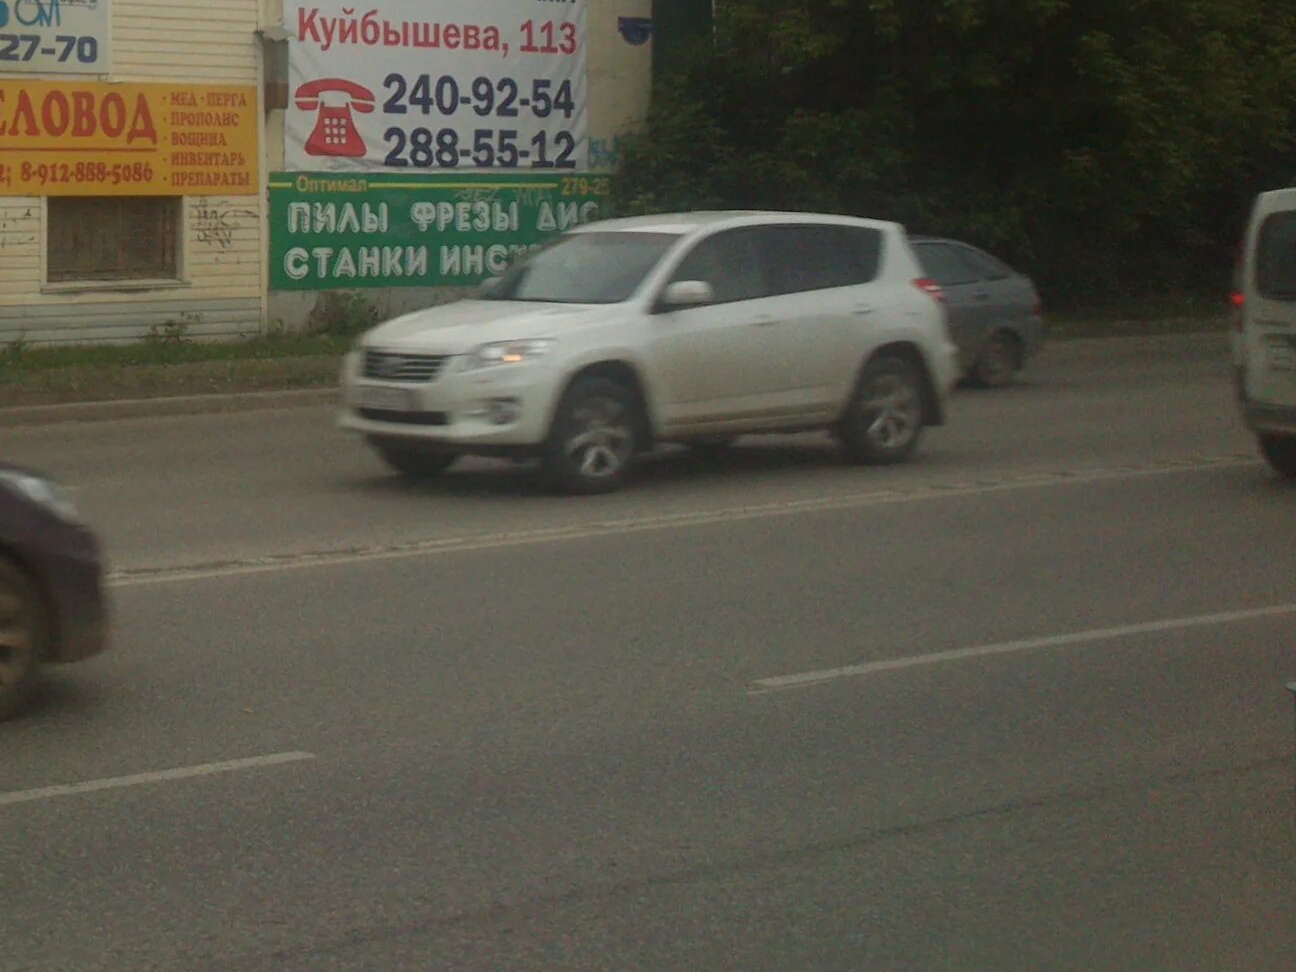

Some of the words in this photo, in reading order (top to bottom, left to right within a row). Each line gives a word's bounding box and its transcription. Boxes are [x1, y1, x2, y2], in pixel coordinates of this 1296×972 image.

[297, 7, 509, 58] Куйбышева,
[519, 19, 577, 55] 113
[206, 92, 247, 107] ПЕРГА
[383, 73, 575, 119] 240-92-54
[170, 111, 240, 127] ПРОПОЛИС
[170, 132, 227, 147] ВОЩИНА
[384, 127, 576, 168] 288-55-12
[170, 152, 246, 166] ИНВЕНТАРЬ
[170, 172, 250, 186] ПРЕПАРАТЫ
[287, 201, 389, 234] ПИЛЫ
[409, 200, 519, 233] ФРЕЗЫ
[536, 200, 600, 232] ДИС
[283, 246, 429, 279] СТАНКИ
